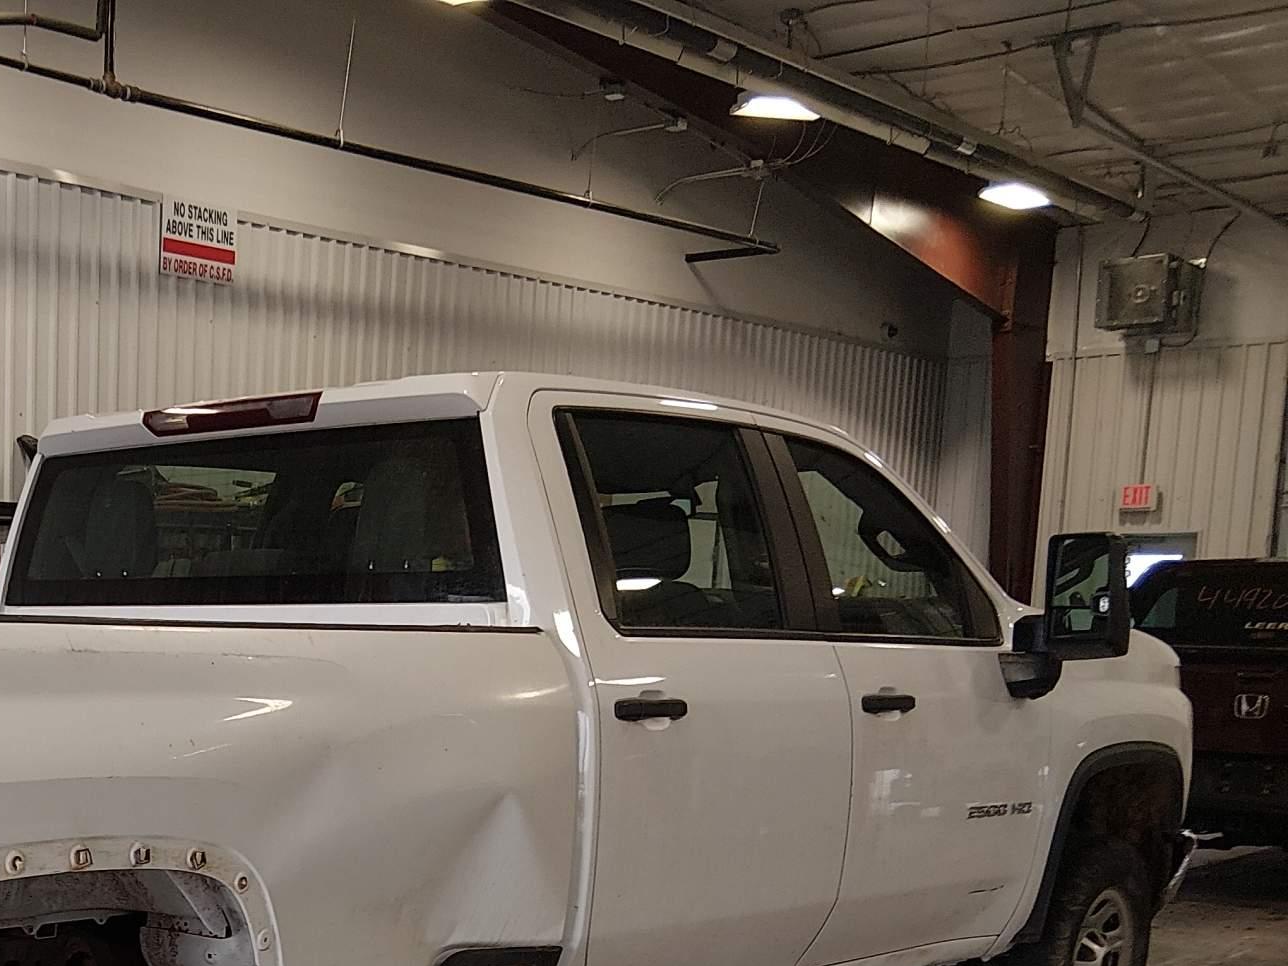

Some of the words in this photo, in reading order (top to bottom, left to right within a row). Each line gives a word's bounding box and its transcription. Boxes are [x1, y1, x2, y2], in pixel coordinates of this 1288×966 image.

[173, 201, 186, 217] NO
[188, 205, 228, 226] STACKING
[166, 218, 194, 239] ABOVE
[196, 225, 214, 243] THIS
[216, 228, 234, 246] LINE
[162, 256, 172, 271] BY
[173, 257, 198, 275] ORDER
[198, 263, 208, 278] OF
[209, 264, 234, 282] C.S.F.D.
[1122, 485, 1151, 506] EXIT
[967, 803, 1008, 819] 2500
[1011, 801, 1033, 815] HD
